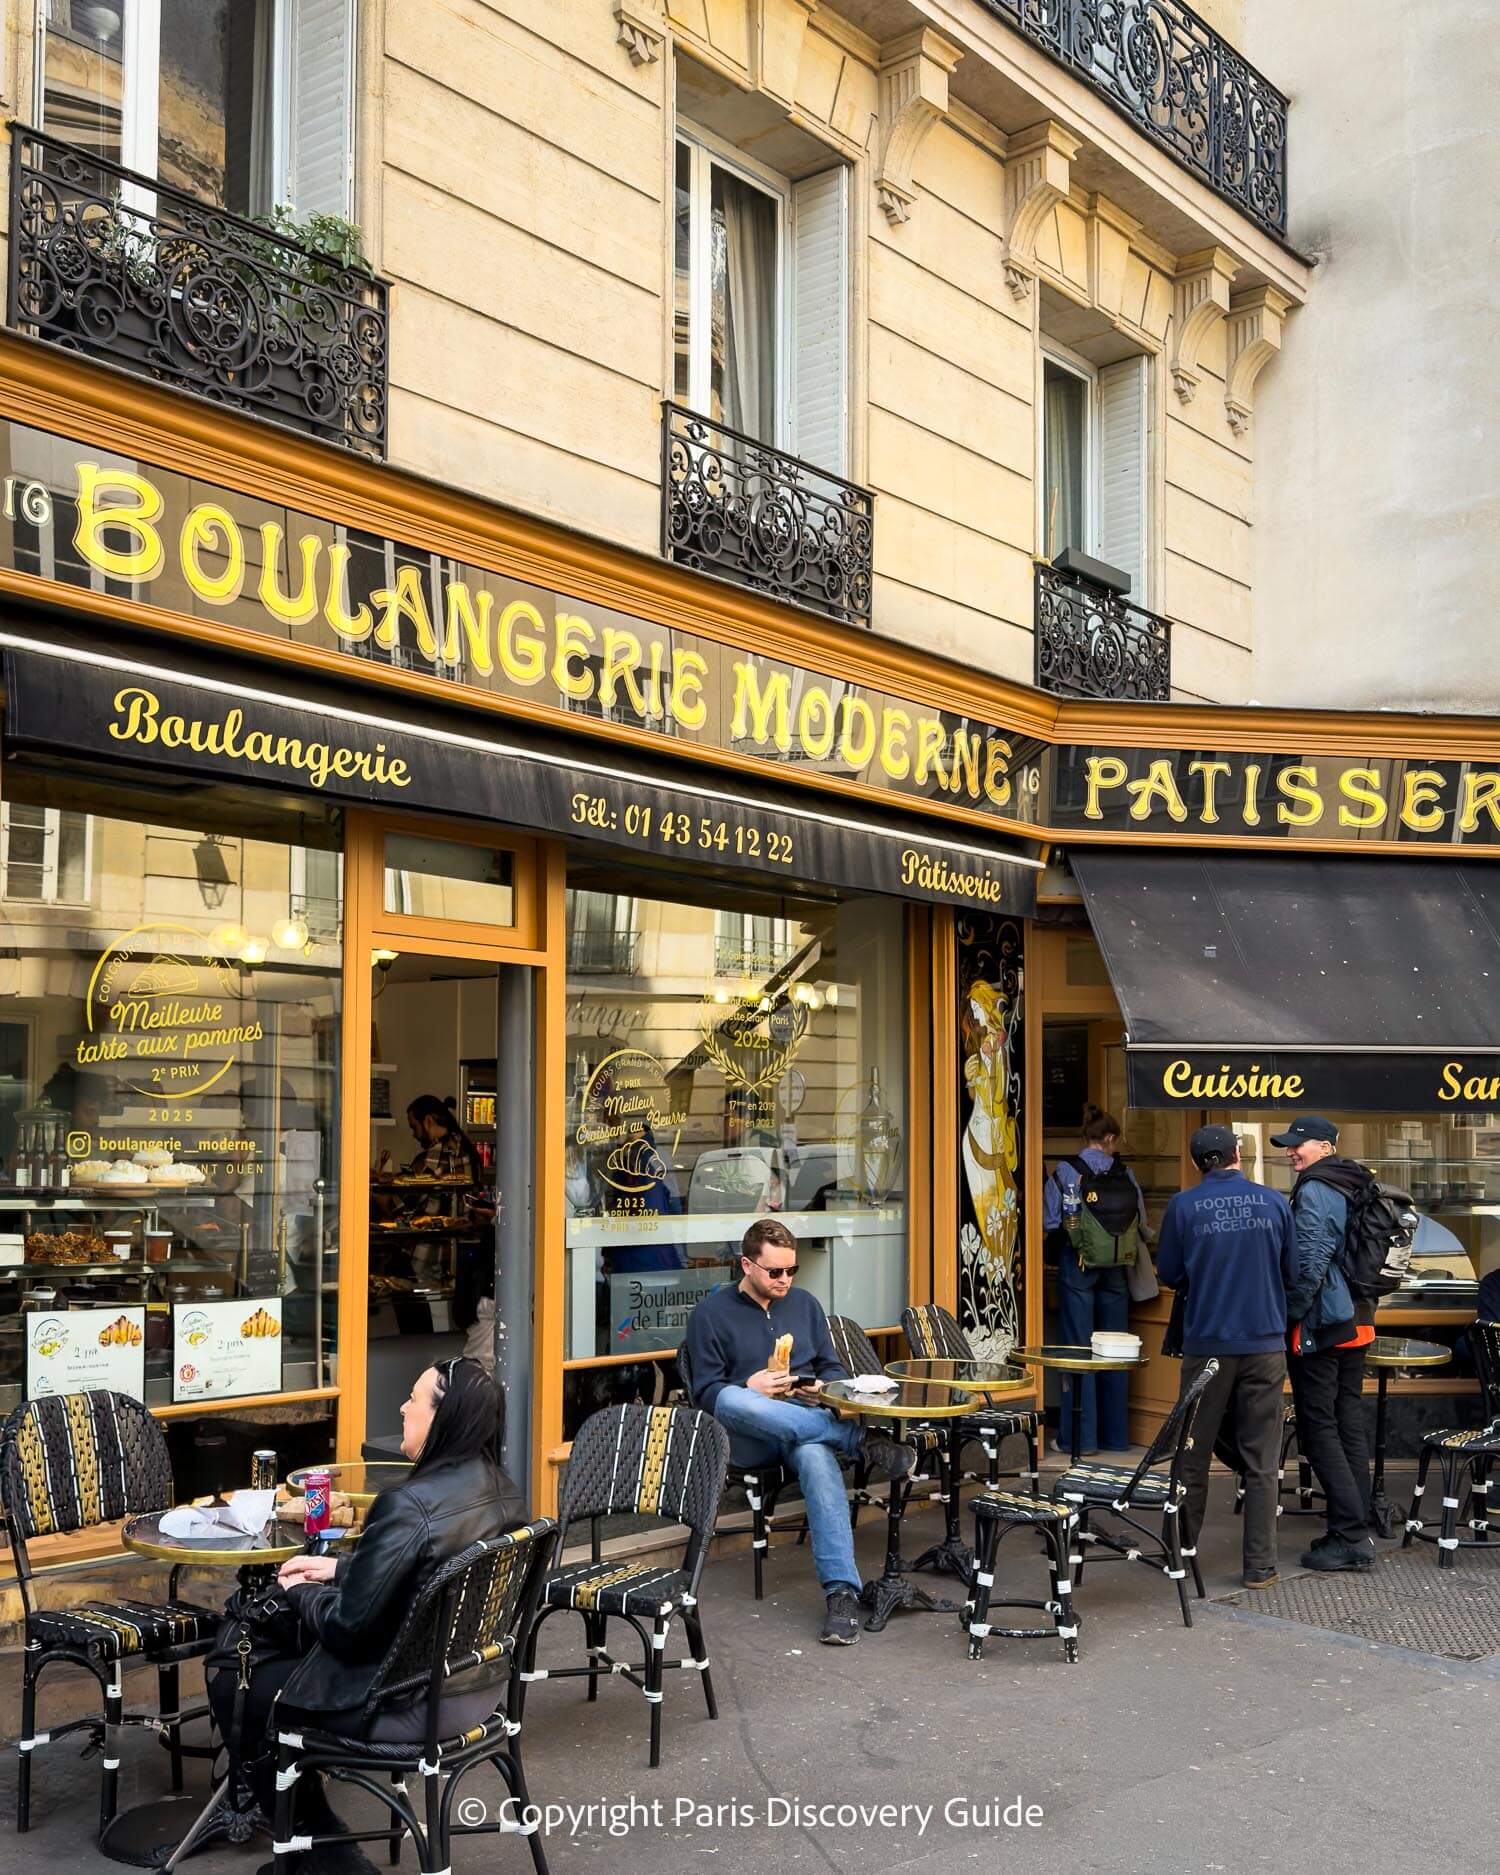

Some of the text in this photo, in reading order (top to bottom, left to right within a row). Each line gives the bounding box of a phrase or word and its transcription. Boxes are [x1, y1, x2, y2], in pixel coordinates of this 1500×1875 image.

[3, 478, 51, 526] 16
[72, 461, 1014, 807] BOULANGERIE MODERNE
[108, 687, 411, 787] Boulangerie
[1022, 763, 1041, 796] 16
[1084, 756, 1500, 833] PATISSER
[571, 793, 793, 864] Tél: 01 43 54 12 22
[901, 849, 1002, 903] Pâtisserie
[99, 943, 142, 1003] CONCOURS
[110, 1000, 222, 1032] Meilleure
[771, 1015, 789, 1026] Paris
[77, 1021, 263, 1064] tarte aux pommes
[734, 1030, 770, 1049] 2025
[171, 1064, 200, 1079] PRIX
[615, 1057, 642, 1070] GRAND
[624, 1079, 642, 1089] PRIX
[1163, 1060, 1304, 1098] Cuisine
[149, 1109, 193, 1122] 2025
[604, 1095, 655, 1117] Meilleur
[576, 1109, 687, 1145] Croissant au Beurre
[226, 1163, 264, 1175] OUEN
[616, 1197, 646, 1208] 2023
[1194, 1194, 1268, 1212] FOOTBALL
[1215, 1207, 1252, 1221] CLUB
[629, 1280, 711, 1310] Boulanger
[631, 1310, 689, 1331] de Fran
